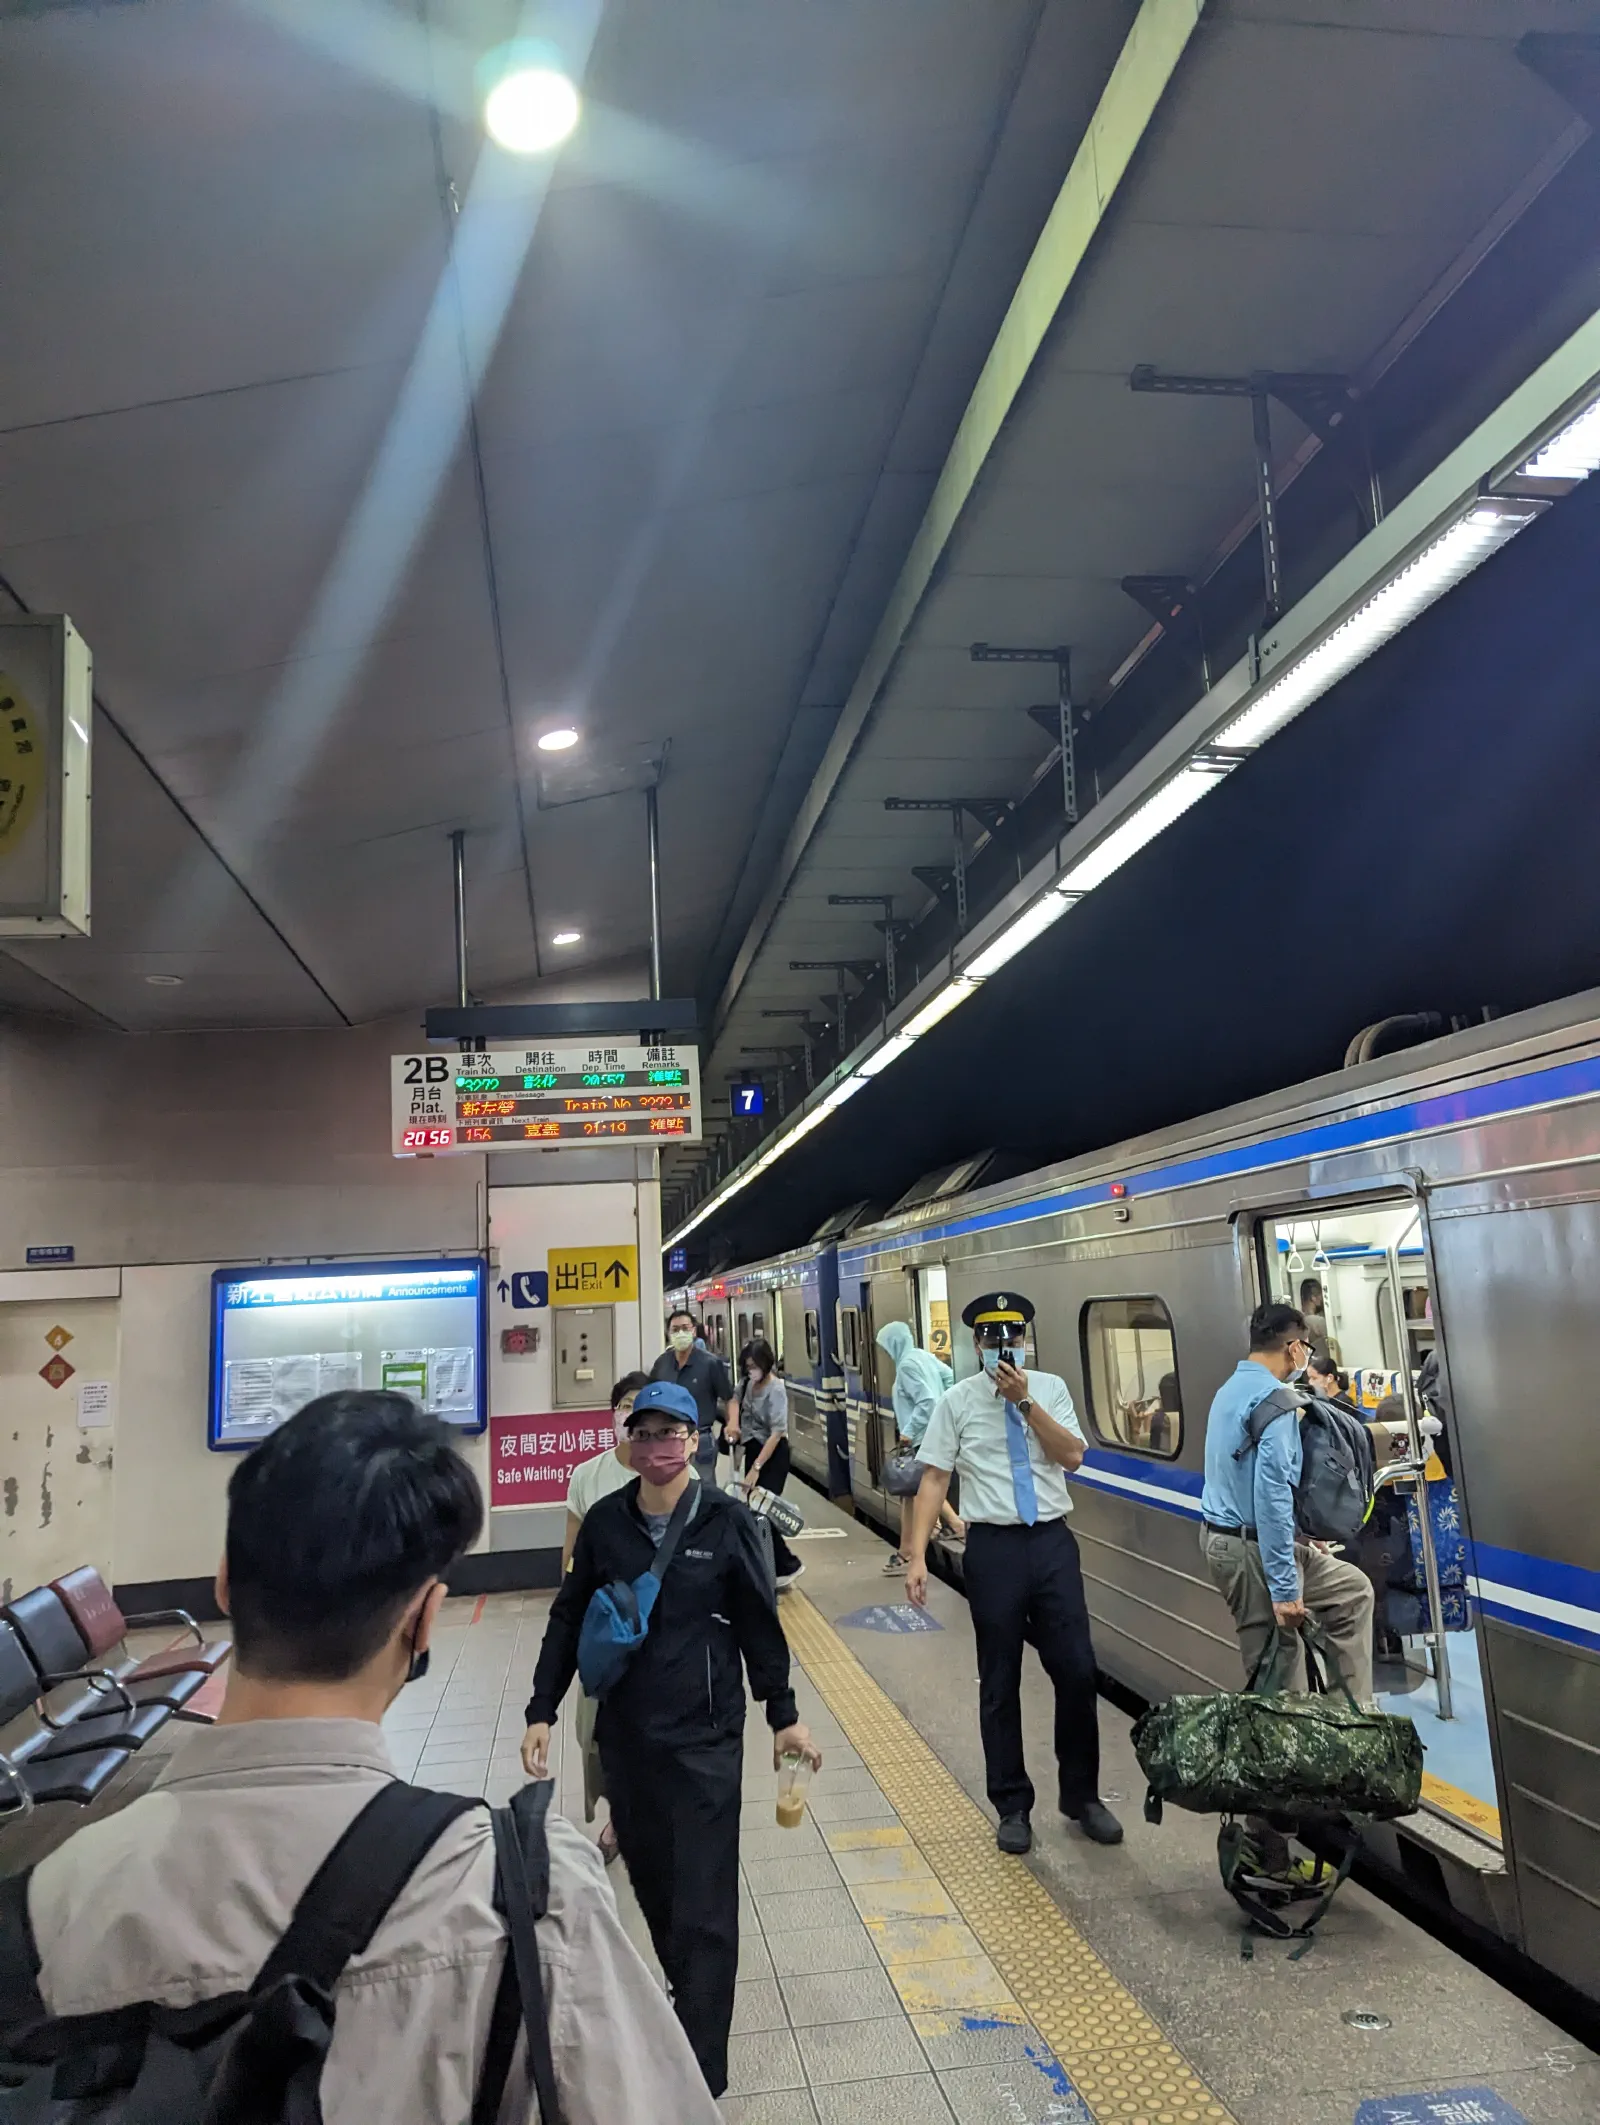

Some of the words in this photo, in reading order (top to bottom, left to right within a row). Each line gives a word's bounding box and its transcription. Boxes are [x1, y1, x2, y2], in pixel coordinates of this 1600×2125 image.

[461, 1053, 492, 1068] 車次
[525, 1051, 556, 1066] 開往
[588, 1049, 618, 1063] 時間
[646, 1047, 676, 1062] 備註
[403, 1056, 450, 1085] 2B
[456, 1068, 479, 1076] Train
[481, 1067, 498, 1075] NO.
[515, 1065, 566, 1074] Destination
[582, 1063, 602, 1072] Dep.
[604, 1063, 626, 1071] Time
[642, 1061, 681, 1069] Remarks
[413, 1086, 442, 1101] 月台
[741, 1090, 755, 1110] 7
[411, 1102, 444, 1115] Plat.
[565, 1099, 608, 1112] Train
[409, 1115, 447, 1125] 現在時刻
[555, 1262, 597, 1292] 出口
[388, 1284, 468, 1297] Announcements
[582, 1280, 603, 1291] Exit
[500, 1428, 615, 1458] 夜間安心候車
[497, 1468, 522, 1484] Safe
[524, 1465, 564, 1483] Waiting
[770, 1505, 800, 1531] Roots
